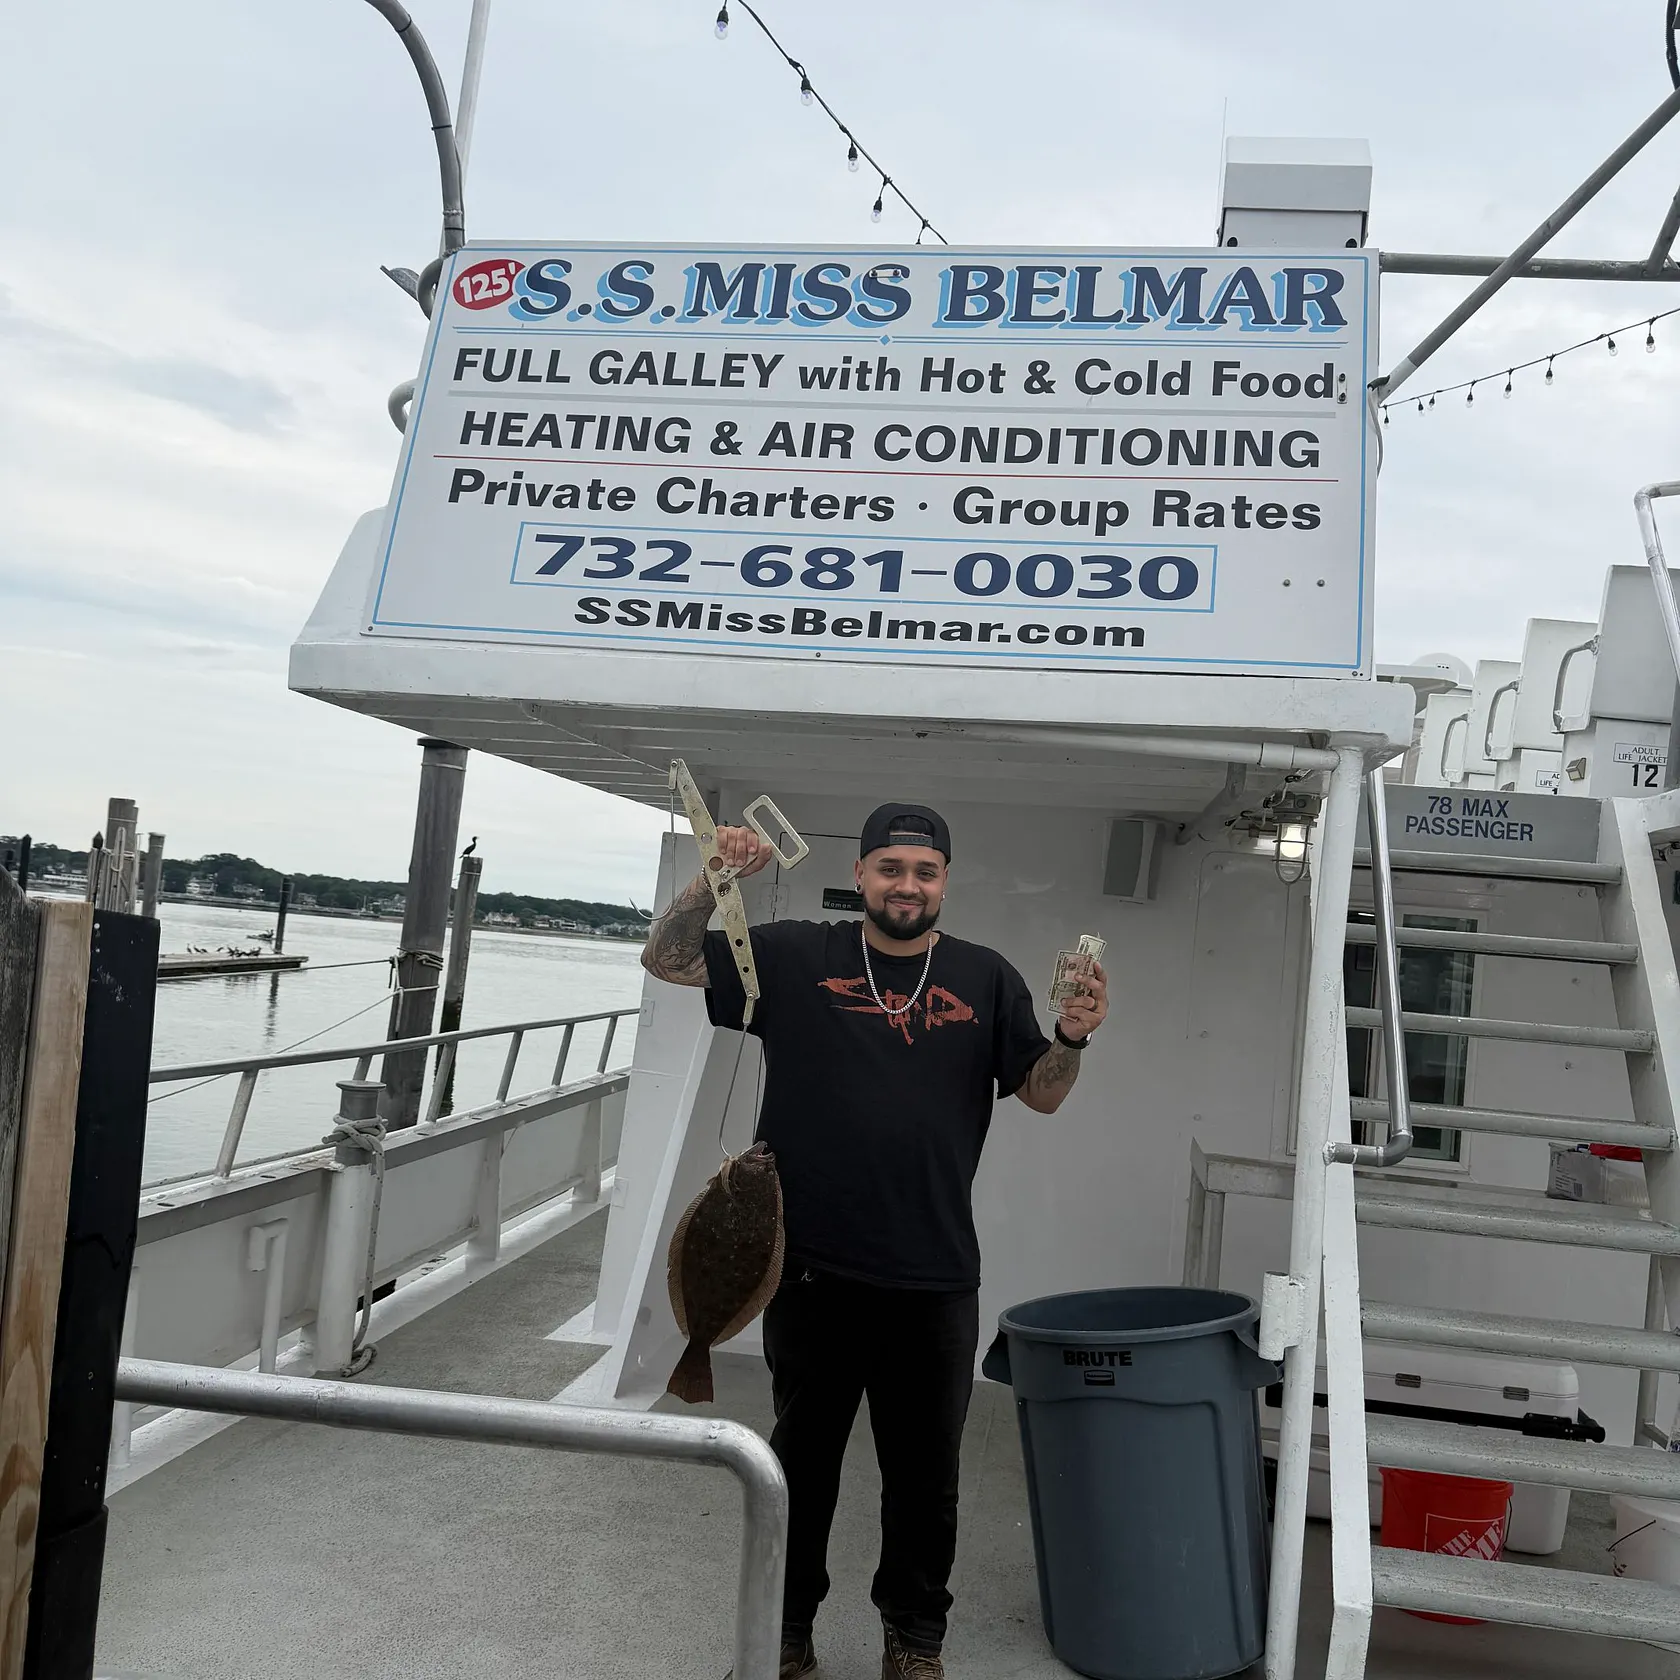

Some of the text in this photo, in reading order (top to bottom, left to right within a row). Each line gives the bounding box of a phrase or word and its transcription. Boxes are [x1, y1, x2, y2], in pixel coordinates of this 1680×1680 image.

[460, 261, 518, 304] 125'
[933, 263, 1349, 333] BELMAR
[453, 348, 1333, 398] FULL GALLEY with Hot & Cold Food
[460, 411, 1319, 468] HEATING & AIR CONDITIONING
[448, 468, 1320, 536] Private Charters Group Rates
[533, 533, 1200, 601] 732-681-0030
[574, 597, 1145, 647] SSMissBelmar.com
[1618, 753, 1667, 764] LIFE JACKET
[1632, 746, 1660, 756] ADULT
[1631, 763, 1659, 788] 12
[1428, 796, 1509, 818] 78 MAX
[1406, 815, 1533, 841] PASSENGER
[1063, 1350, 1133, 1367] BRUTE
